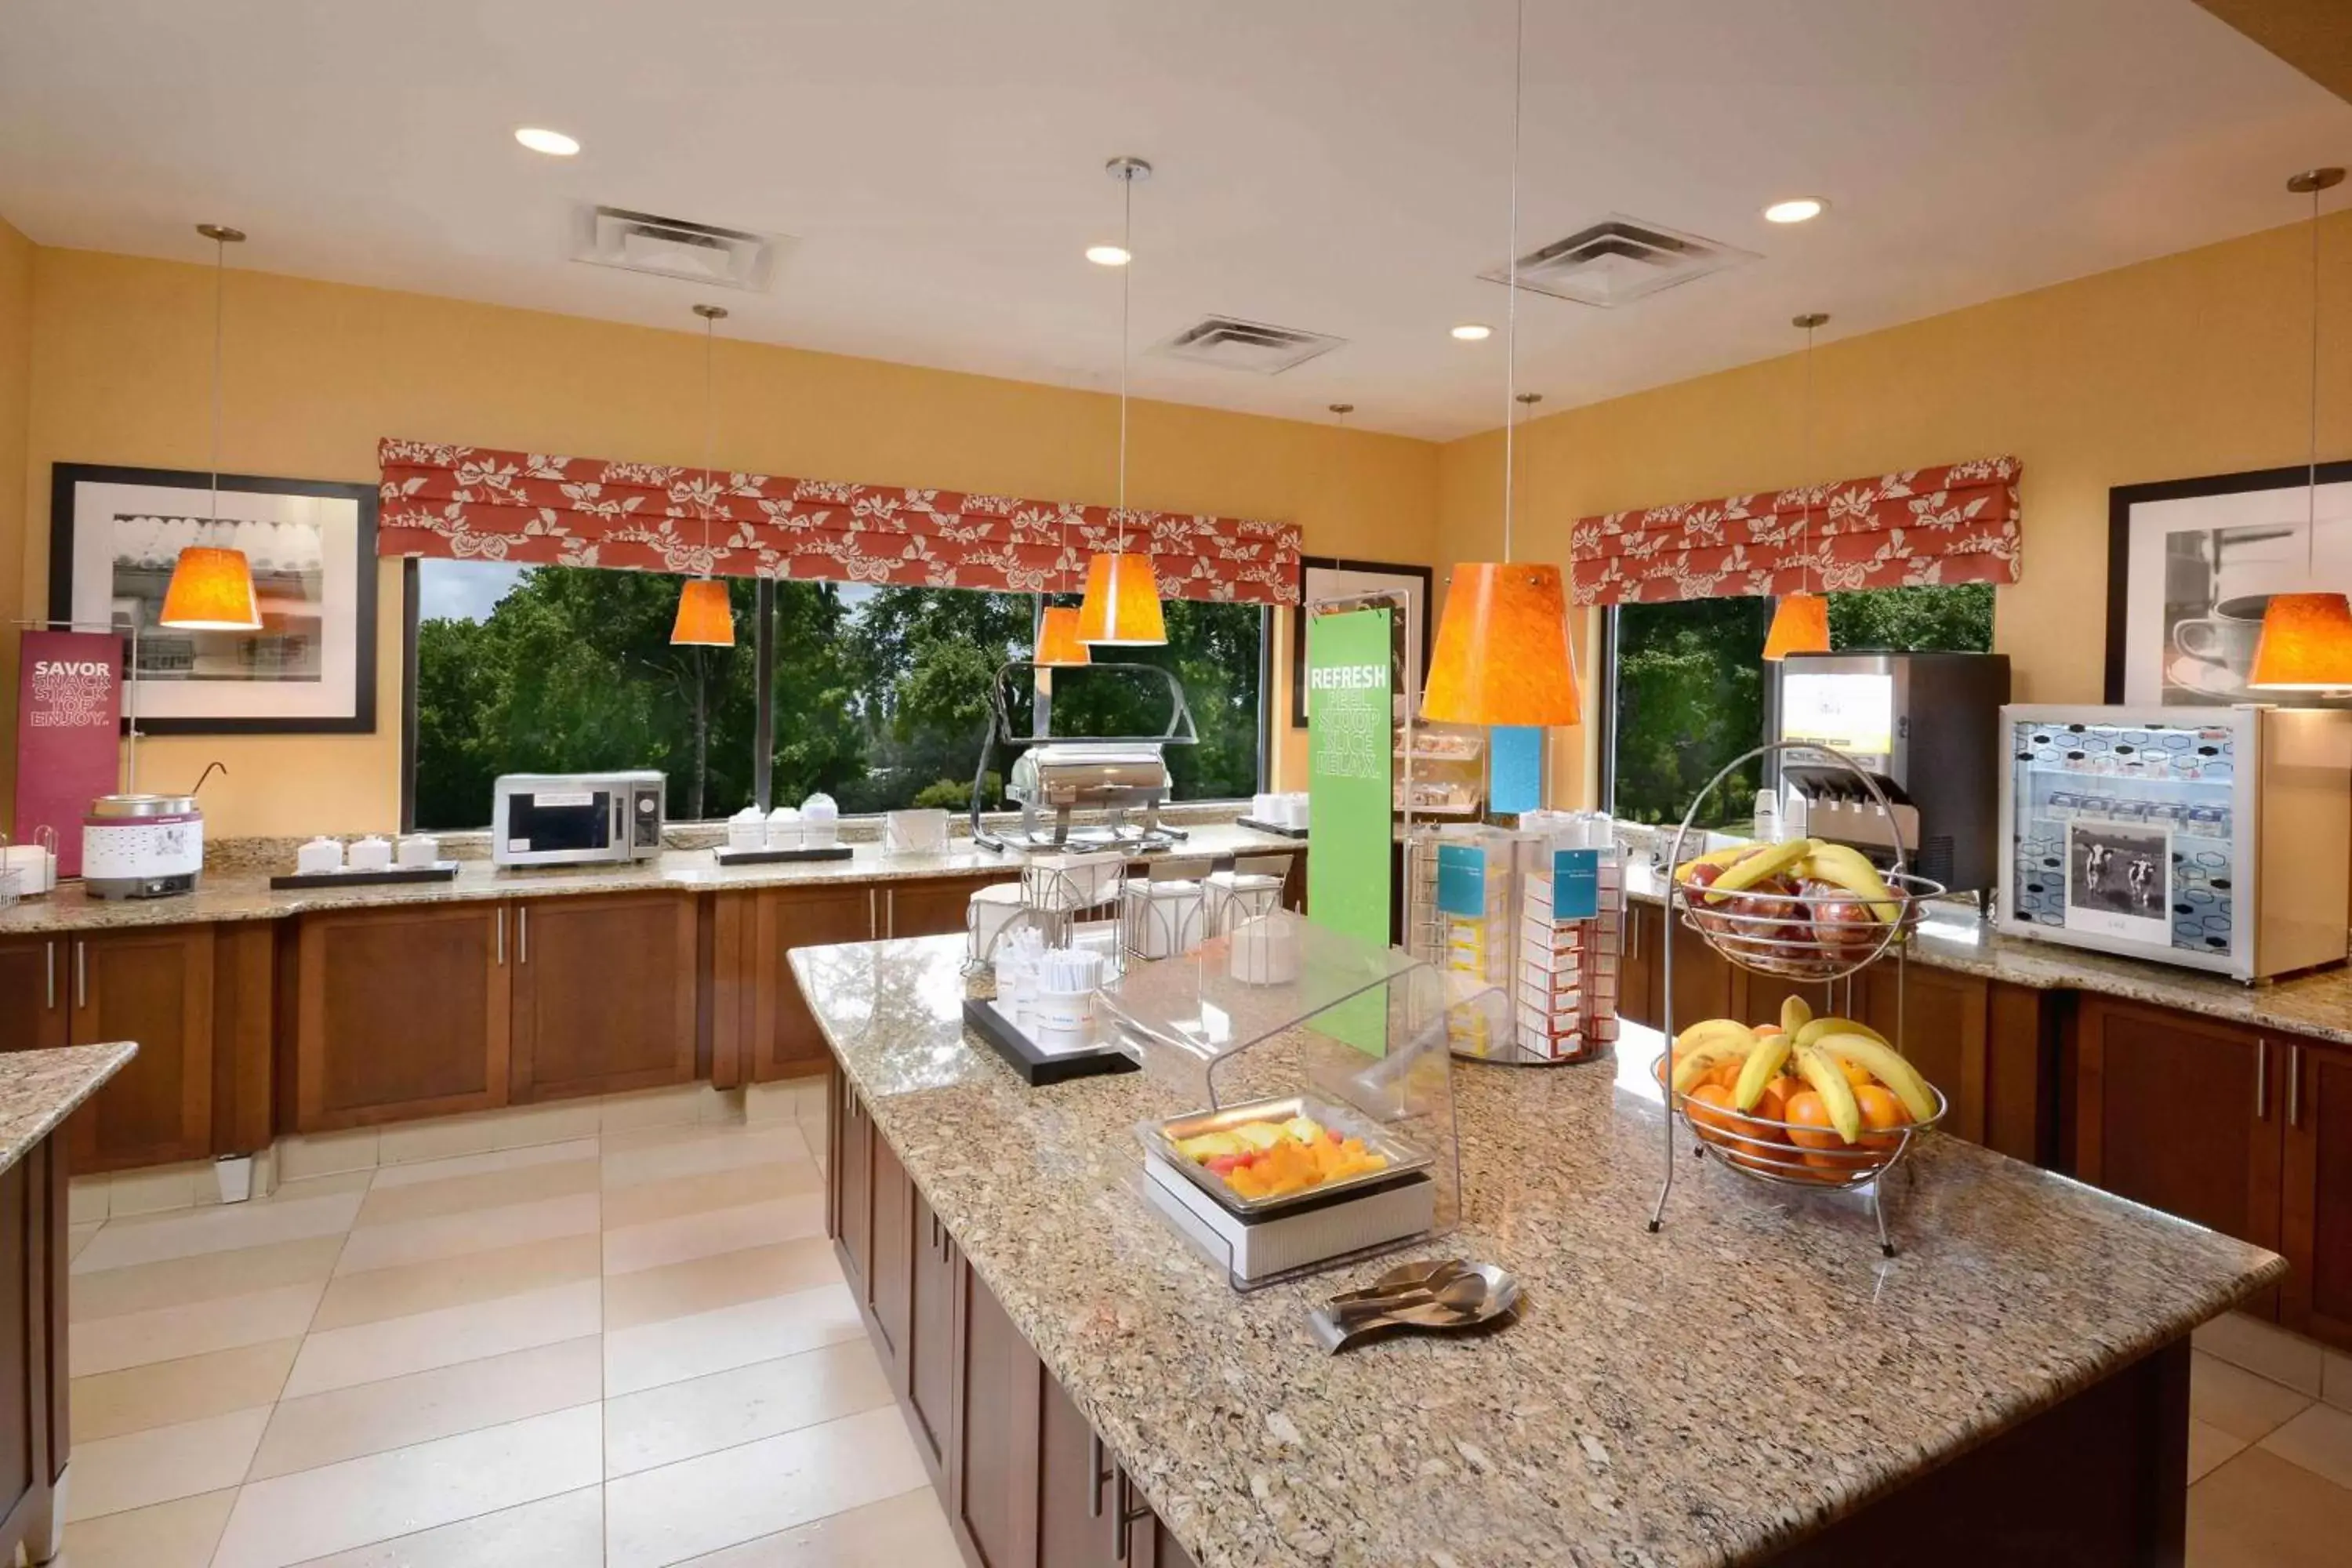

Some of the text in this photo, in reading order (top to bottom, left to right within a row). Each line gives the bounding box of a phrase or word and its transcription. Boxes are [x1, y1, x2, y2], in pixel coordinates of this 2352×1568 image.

[35, 662, 110, 675] SAVOR
[32, 674, 111, 689] SNACK
[1312, 665, 1386, 689] REFRESH
[34, 688, 108, 702] STACK
[1318, 708, 1381, 733] SCOOP
